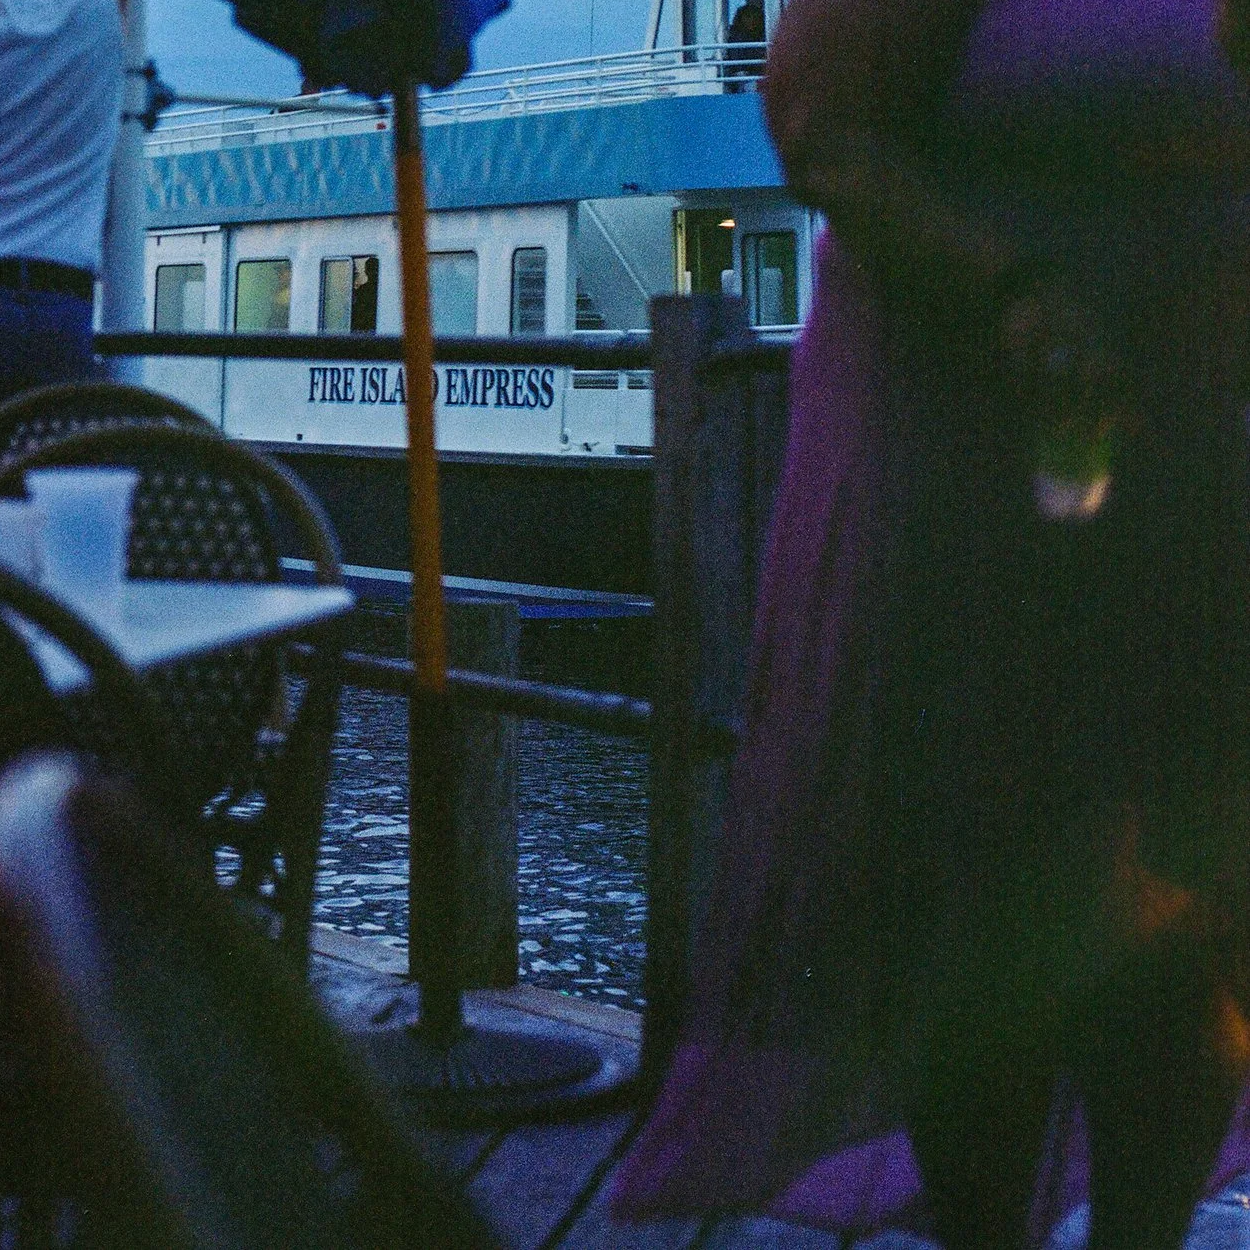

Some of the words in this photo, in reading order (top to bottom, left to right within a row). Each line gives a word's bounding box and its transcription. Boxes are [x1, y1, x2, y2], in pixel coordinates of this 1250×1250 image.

[308, 366, 355, 403] FIRE
[359, 366, 440, 405] ISLAD
[444, 368, 555, 409] EMPRESS
